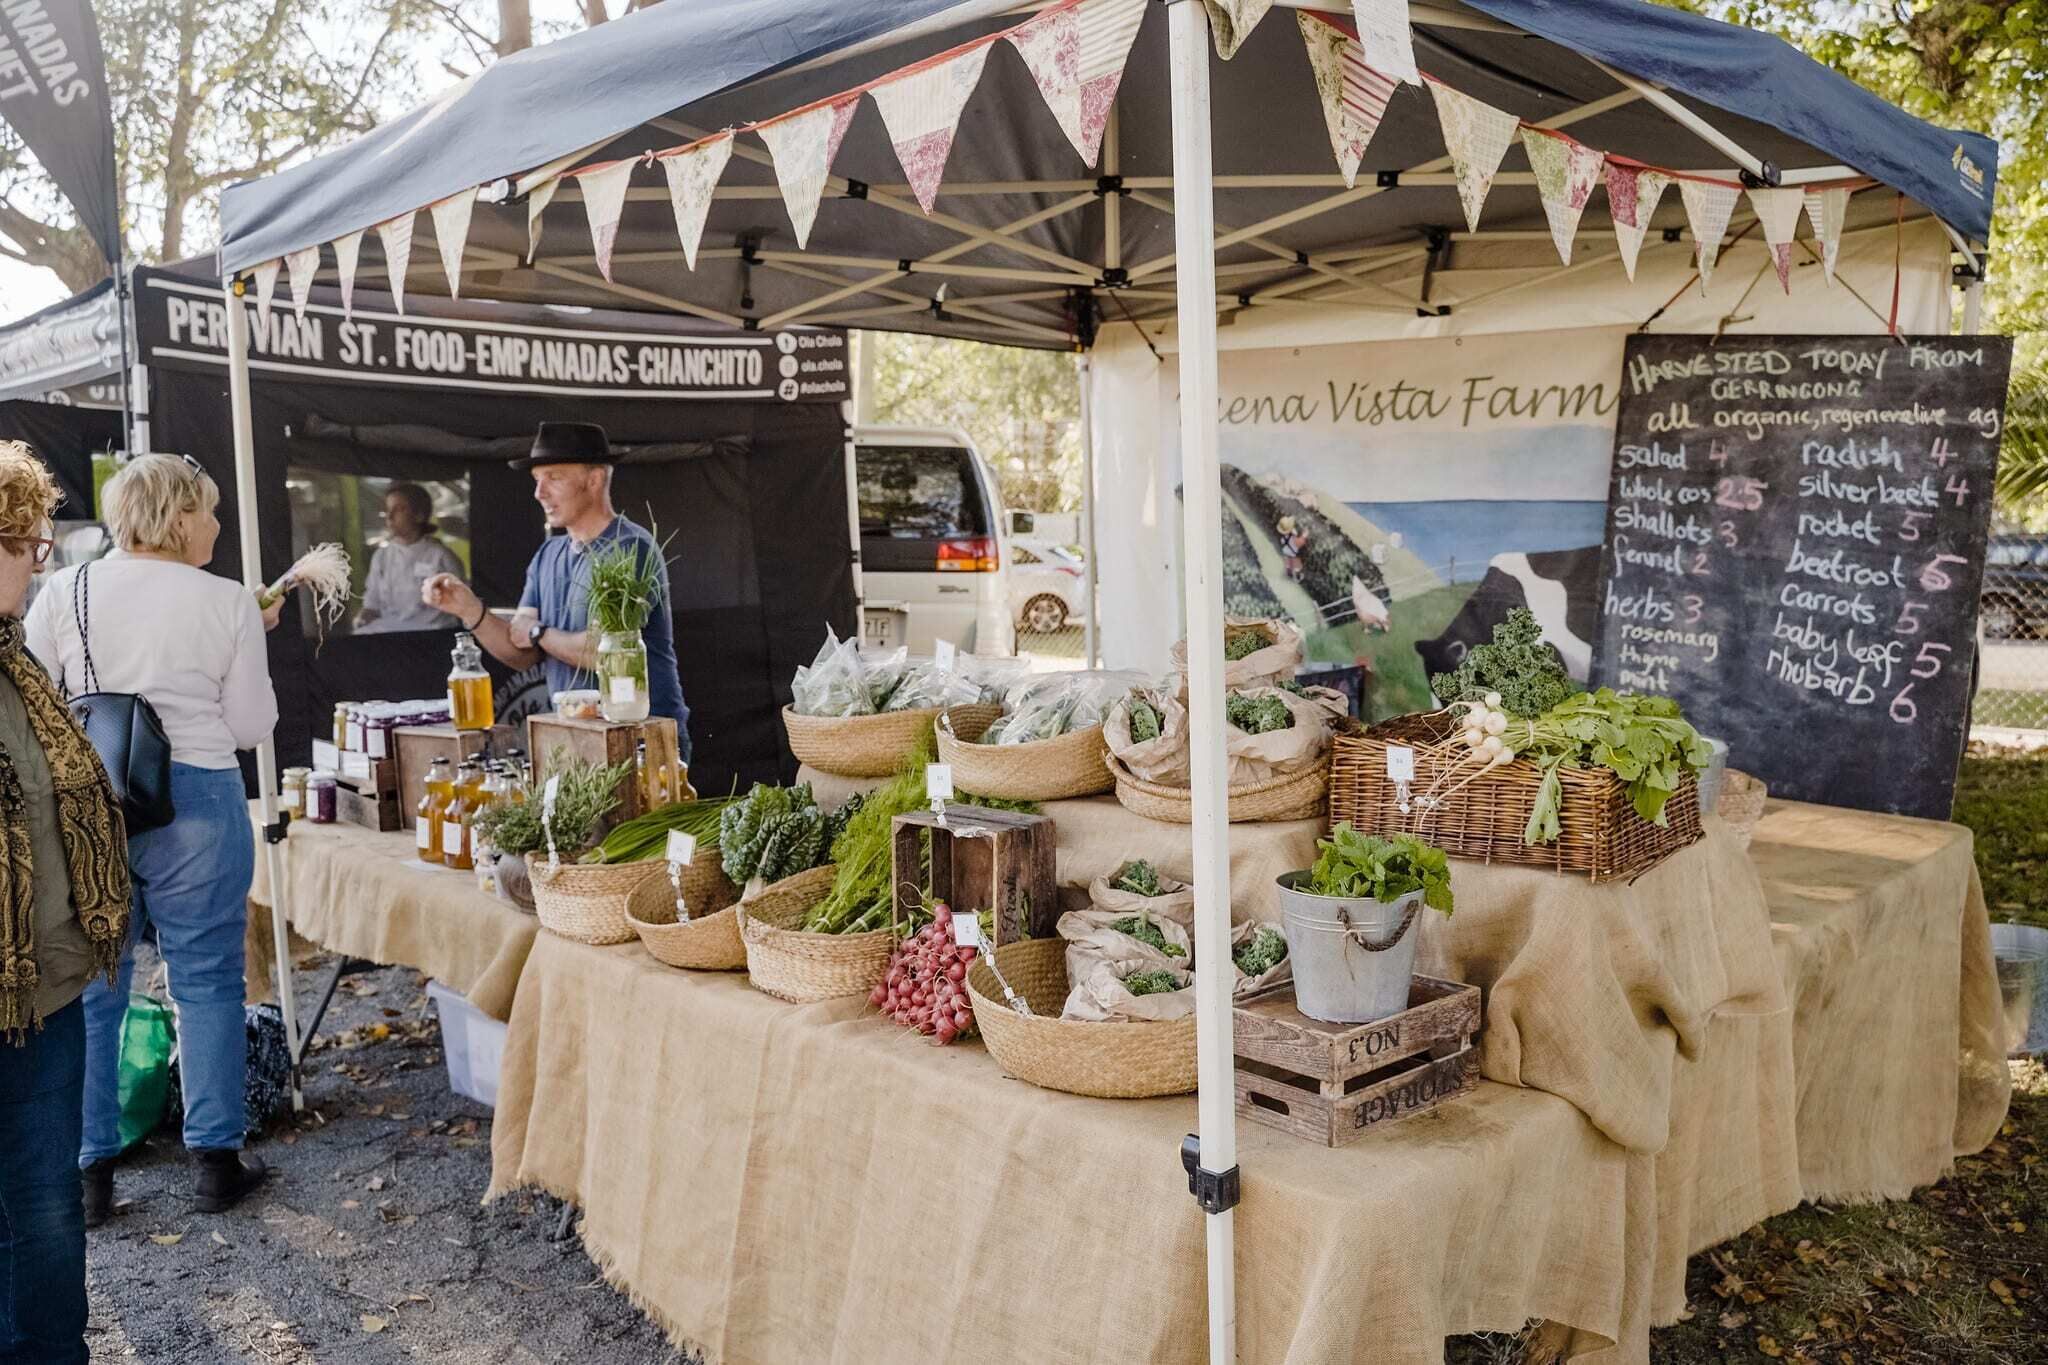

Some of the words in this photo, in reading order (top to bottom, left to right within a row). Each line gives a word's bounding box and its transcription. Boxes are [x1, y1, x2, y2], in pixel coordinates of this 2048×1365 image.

[167, 295, 325, 361] PERVIAN
[338, 321, 388, 367] ST.
[394, 326, 764, 386] FOOD-EMPANADAS-CHANCHITO
[1628, 350, 1791, 395] HARVESTED
[1799, 348, 1887, 380] TODAY
[1909, 347, 1984, 371] FROM
[1327, 379, 1451, 426] Vista
[1462, 375, 1620, 427] Farm
[1647, 402, 1699, 433] all
[1967, 406, 2000, 439] ag
[1708, 439, 1729, 468] 4
[1801, 436, 1904, 473] radish
[1930, 436, 1958, 467] 4
[1944, 474, 1971, 506] 4
[1719, 520, 1739, 548] 3
[1798, 510, 1882, 545] rocket
[1898, 510, 1933, 541] 5
[1691, 553, 1710, 575] 2
[1784, 538, 1906, 588] beetroot
[1604, 579, 1675, 622] herbs
[1683, 594, 1704, 624] 3
[1895, 601, 1929, 634] 5
[1618, 643, 1680, 676] thyme
[1619, 624, 1718, 663] rosemary
[1773, 611, 1838, 671] baby
[1909, 642, 1952, 678] 5
[1766, 646, 1876, 705] rhubarb
[1889, 682, 1917, 724] 6
[1348, 1024, 1401, 1064] NO.3
